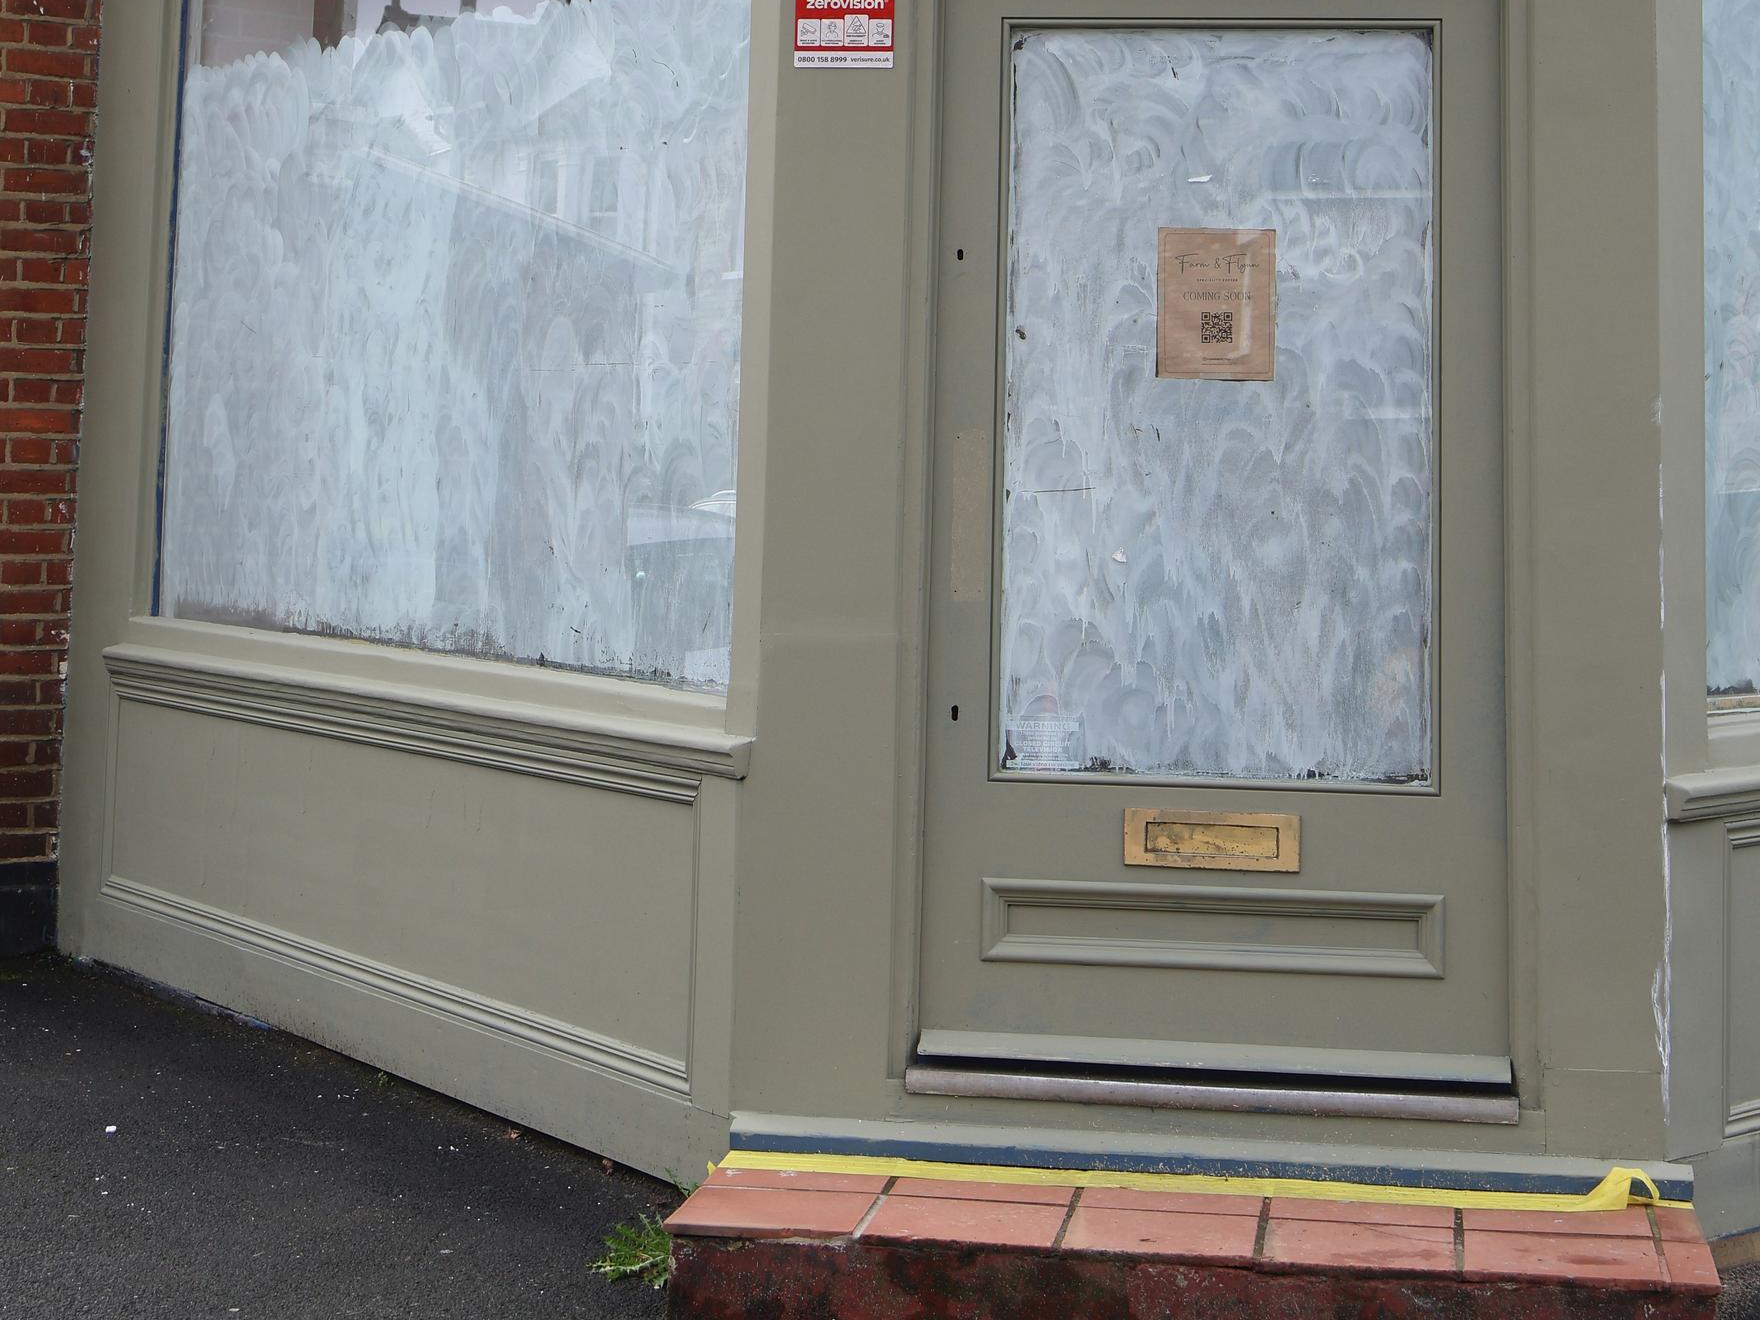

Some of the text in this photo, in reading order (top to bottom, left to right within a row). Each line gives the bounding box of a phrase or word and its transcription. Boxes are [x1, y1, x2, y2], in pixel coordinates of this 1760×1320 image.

[1215, 257, 1221, 269] &
[1183, 291, 1252, 301] COMING SOON
[1016, 722, 1071, 730] WARNING
